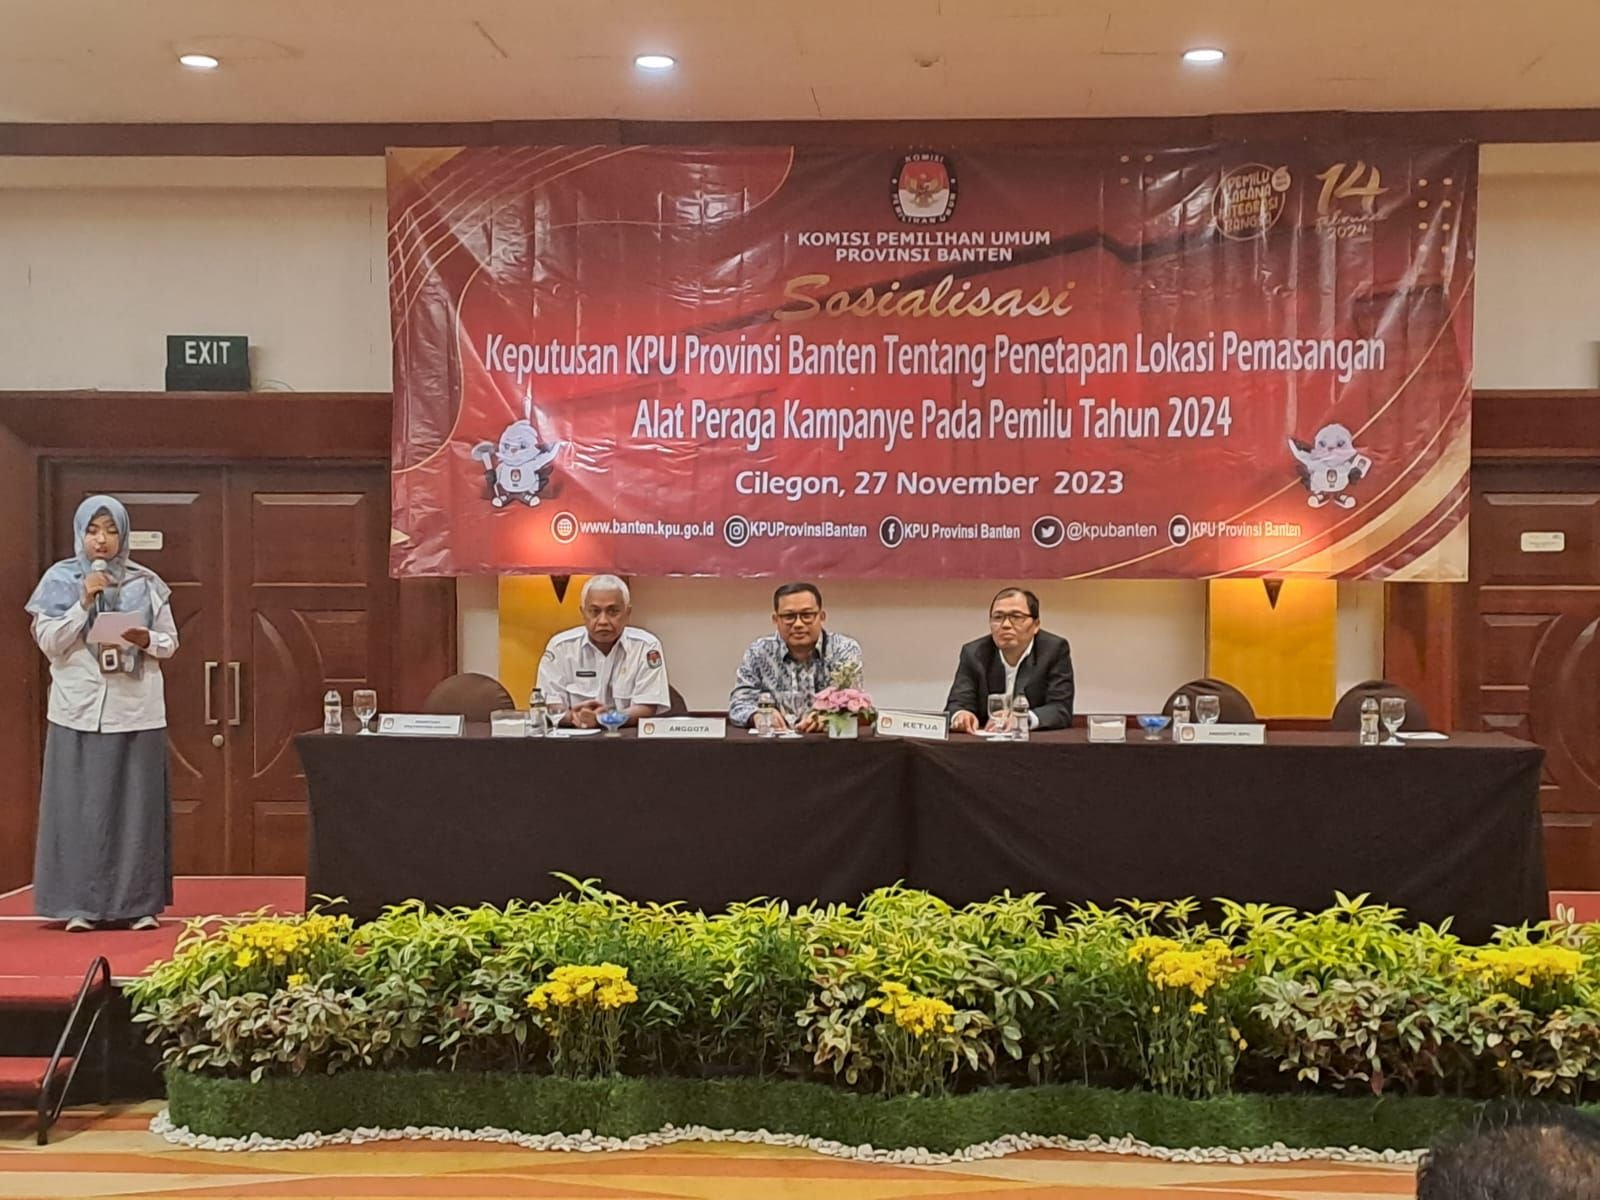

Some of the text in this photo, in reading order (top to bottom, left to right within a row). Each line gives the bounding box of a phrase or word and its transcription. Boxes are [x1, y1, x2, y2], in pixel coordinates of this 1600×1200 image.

[1223, 183, 1272, 205] ARANA
[1314, 160, 1391, 214] 14
[798, 230, 1051, 246] KOMISI PEMILIHAN UMUM
[835, 247, 1014, 262] PROVINSI BANTEN
[773, 274, 1076, 318] Sosialisasi
[185, 341, 231, 364] EXIT
[485, 330, 1385, 388] Keputusan KPU Provinsi Banten Tentang Penetapan Lokasi Pemasangan
[631, 396, 1233, 452] Alat Peraga Kampanye Pada Pemilu Tahun 2024
[735, 471, 1125, 502] Cilegon, 27 November 2023
[579, 518, 715, 540] www.banten.kpu.go.id
[749, 521, 867, 538] KPUProvinsiBanten
[903, 523, 1021, 540] KPU Provinsi Banten
[1066, 521, 1158, 541] @kpubanten
[1191, 521, 1302, 538] KPU Provinsi Banten
[668, 725, 710, 733] ANGGOTA
[902, 721, 939, 731] KETUA
